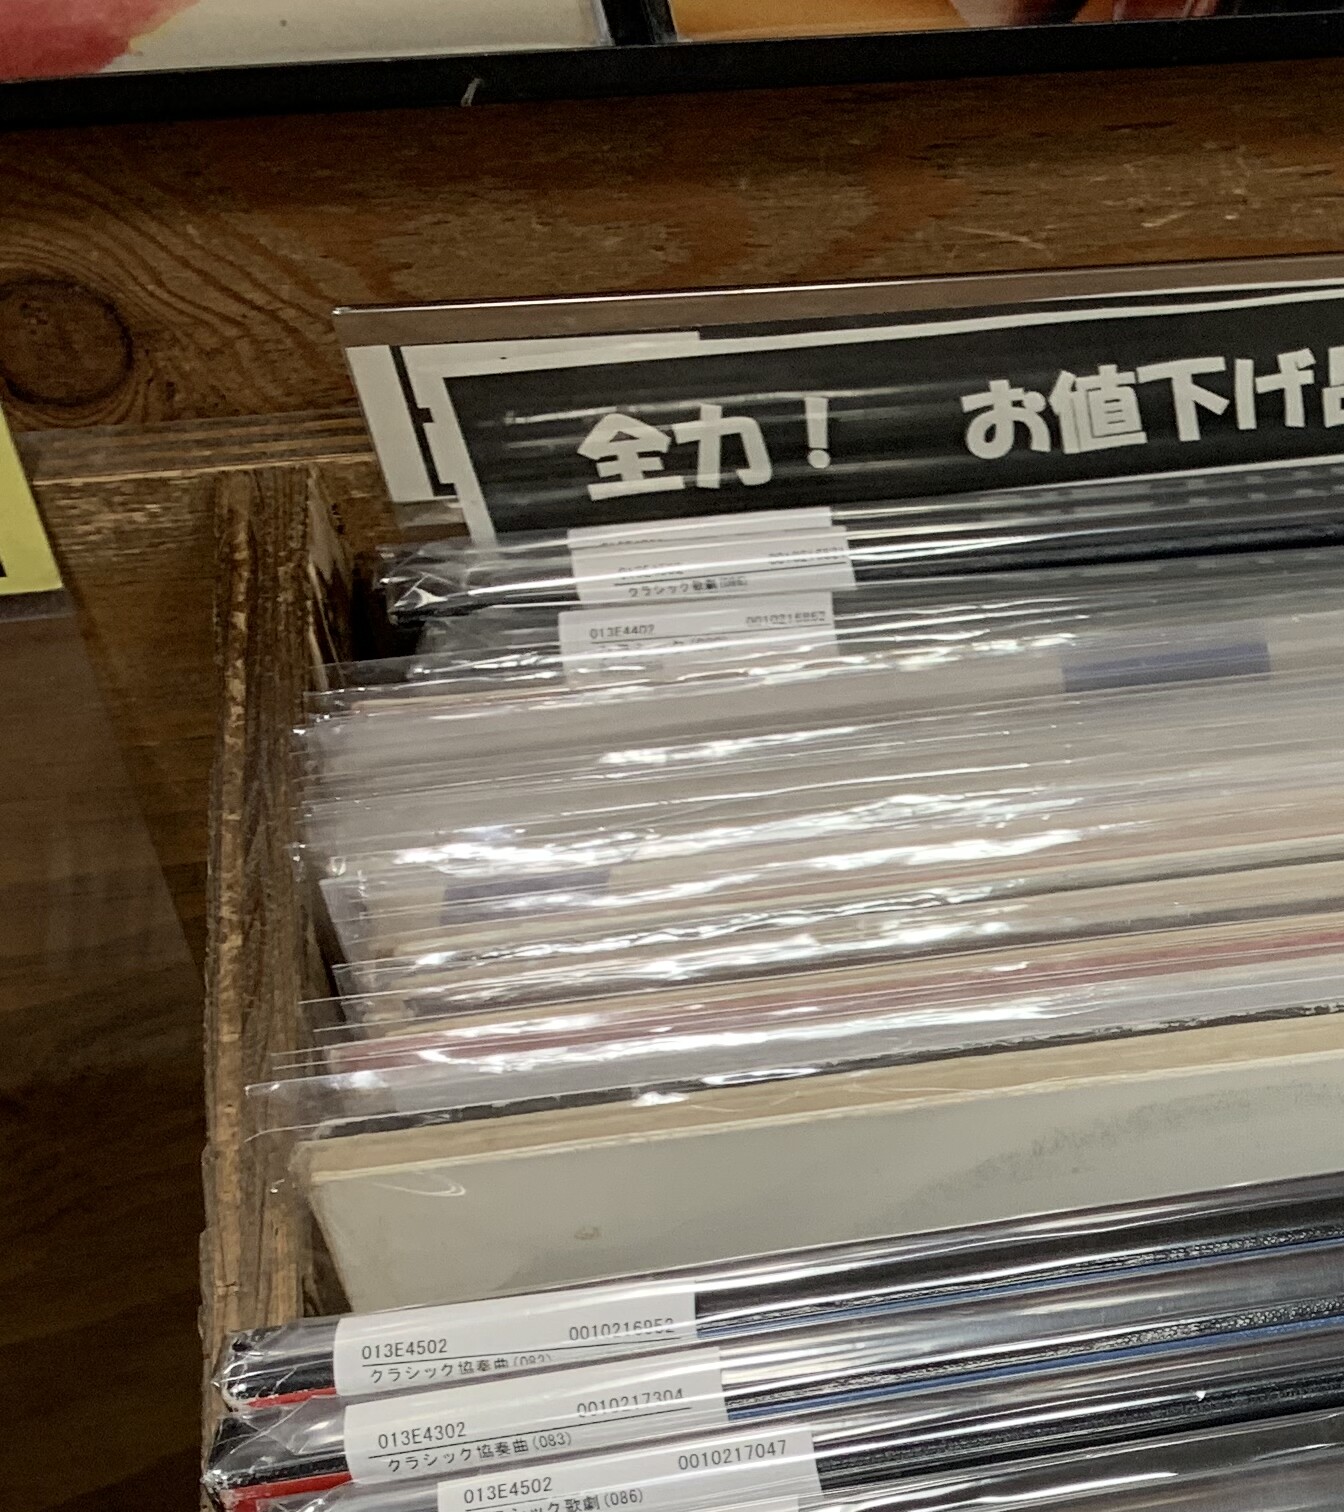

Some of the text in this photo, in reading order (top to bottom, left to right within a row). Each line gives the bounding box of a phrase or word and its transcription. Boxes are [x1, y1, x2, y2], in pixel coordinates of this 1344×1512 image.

[577, 397, 832, 500] 全力！
[361, 1338, 448, 1361] 013E4502
[377, 1421, 467, 1450] 013E4302
[463, 1440, 787, 1505] 013E4502 0010217047
